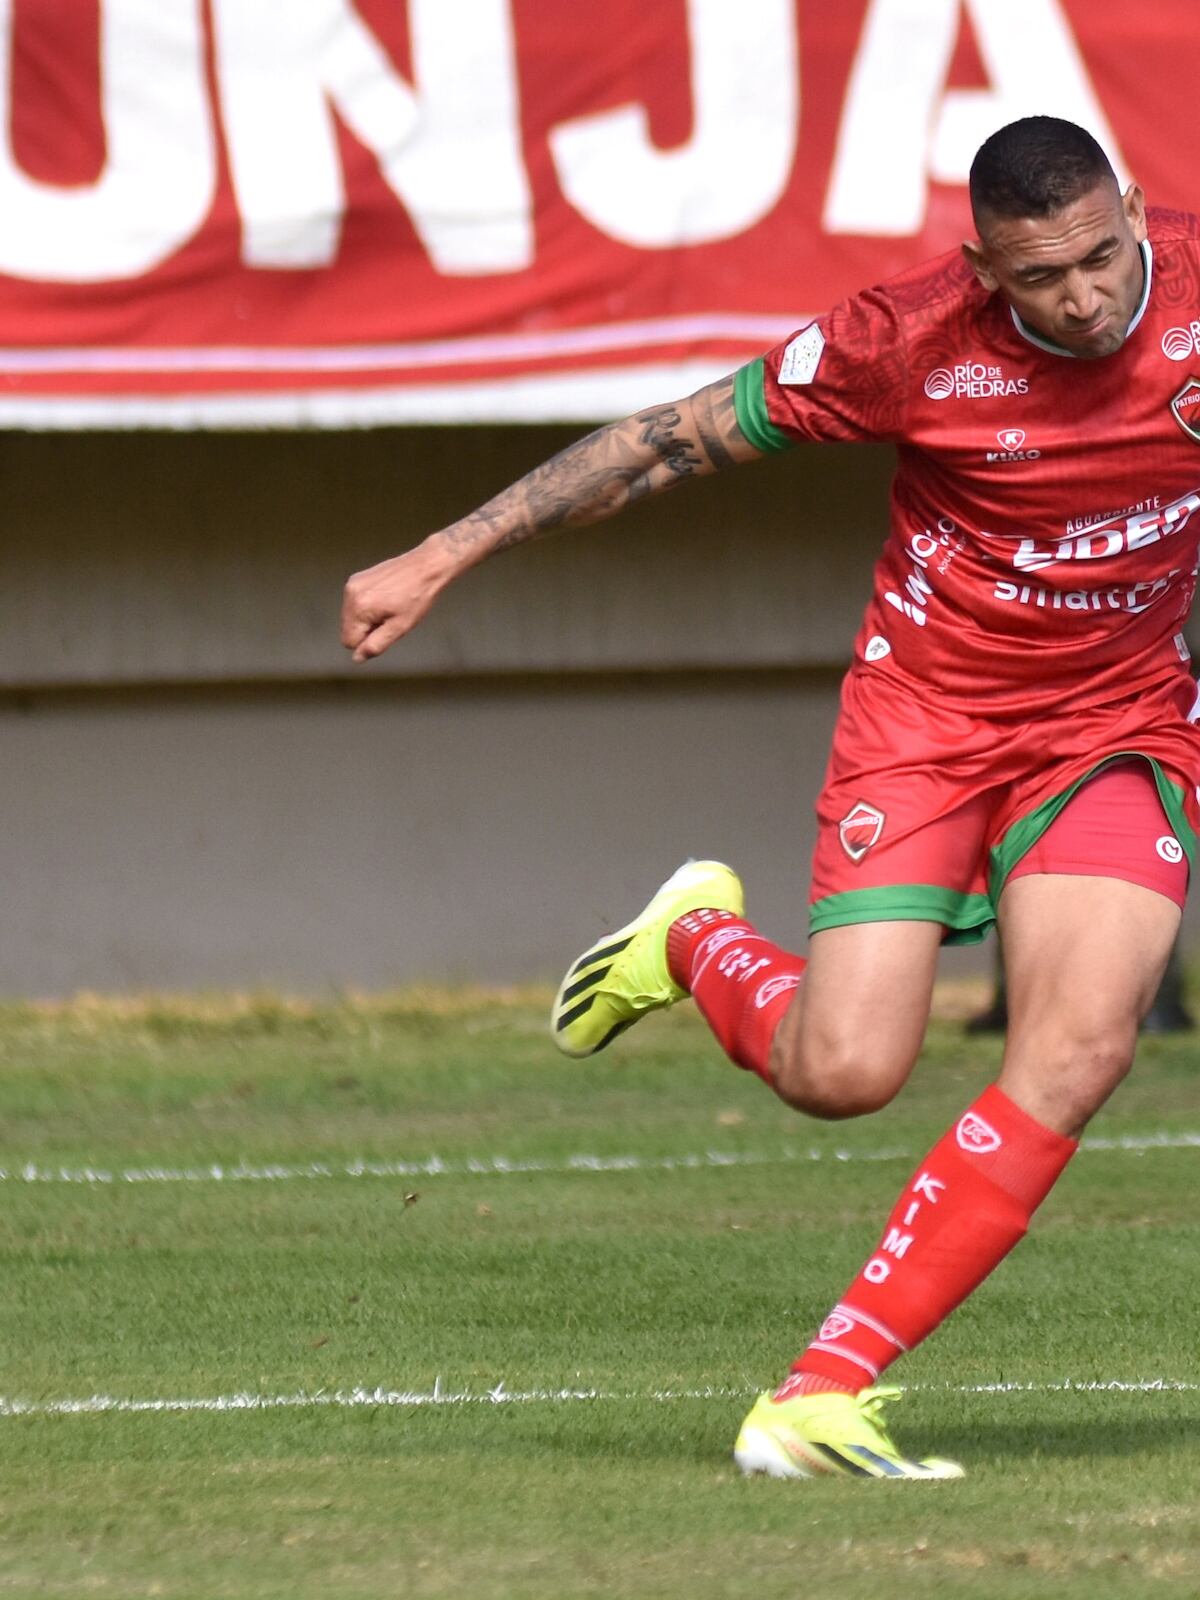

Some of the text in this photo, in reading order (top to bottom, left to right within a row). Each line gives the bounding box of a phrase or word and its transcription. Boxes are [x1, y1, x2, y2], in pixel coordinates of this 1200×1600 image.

[954, 360, 1003, 382] RÍO DE
[955, 378, 1029, 399] PIEDRAS
[986, 449, 1041, 463] KIMO
[863, 1172, 946, 1285] KIMO
